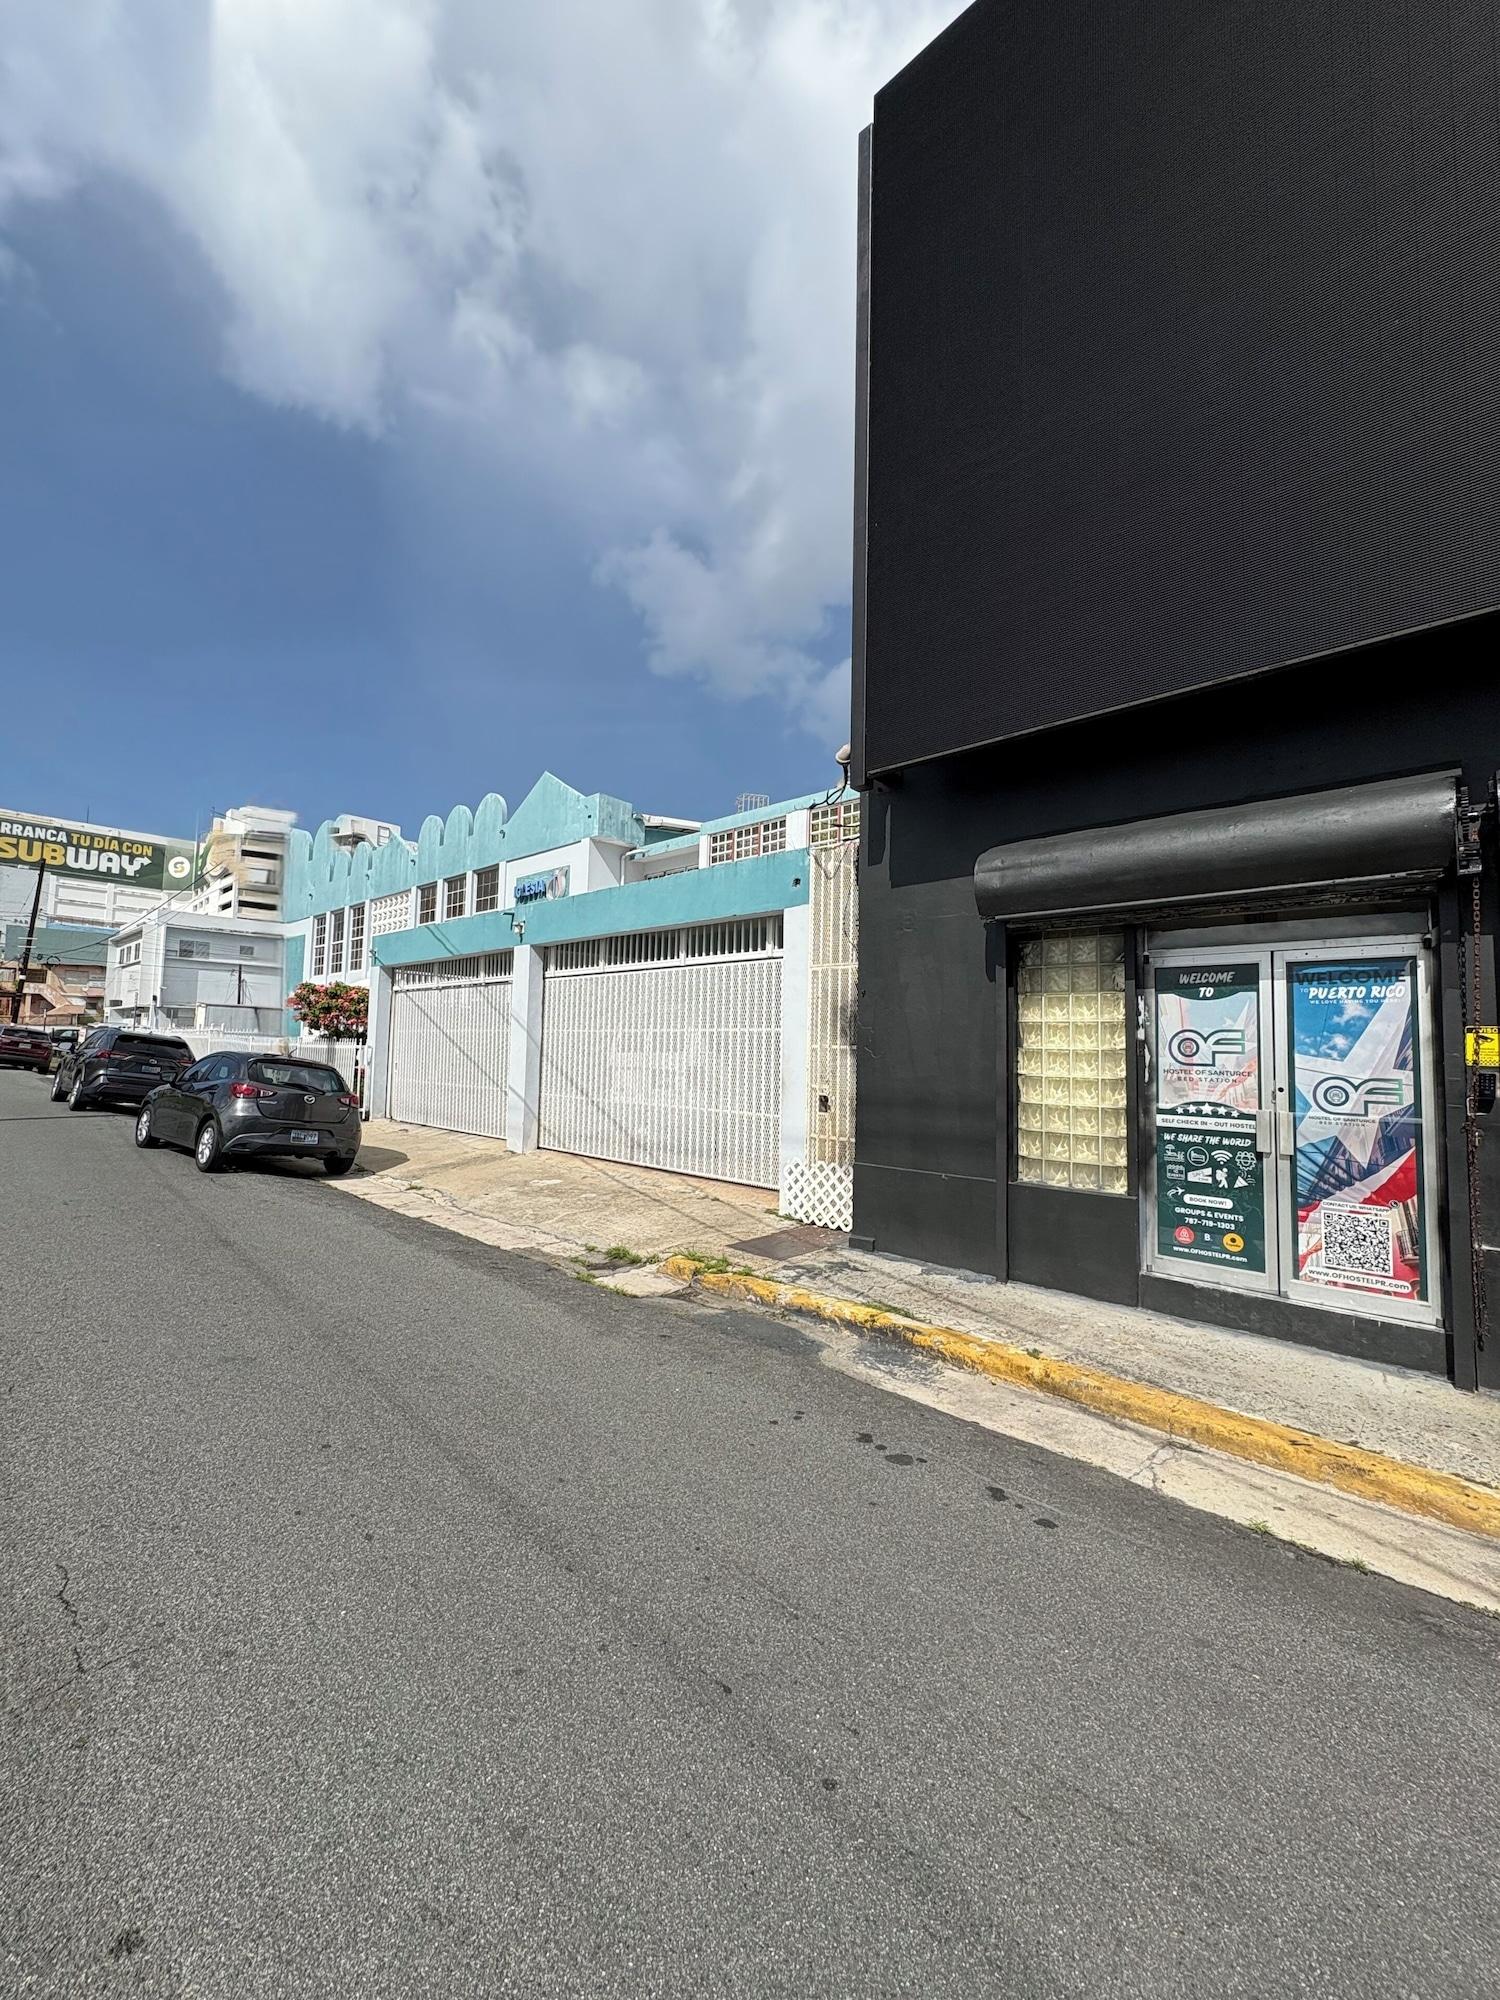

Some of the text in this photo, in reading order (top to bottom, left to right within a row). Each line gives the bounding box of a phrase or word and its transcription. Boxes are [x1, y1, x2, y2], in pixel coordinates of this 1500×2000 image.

[0, 821, 153, 857] RRANCA TU DÍA CON
[0, 837, 152, 877] SUBWAY
[1179, 972, 1236, 984] WELCOME
[1295, 968, 1406, 986] WELCOME
[1198, 986, 1214, 998] TO
[1308, 986, 1366, 999] PUERTO
[1370, 985, 1406, 998] RICO
[1208, 1069, 1253, 1078] SANTURCE
[1164, 1132, 1252, 1147] WE SHARE THE WORLD
[1174, 1206, 1206, 1217] GROUPS
[1214, 1212, 1244, 1222] EVENTS
[1173, 1246, 1248, 1262] www.OFHOSTELPR.com
[1308, 1269, 1410, 1290] www.OFHOSTELPR.com
